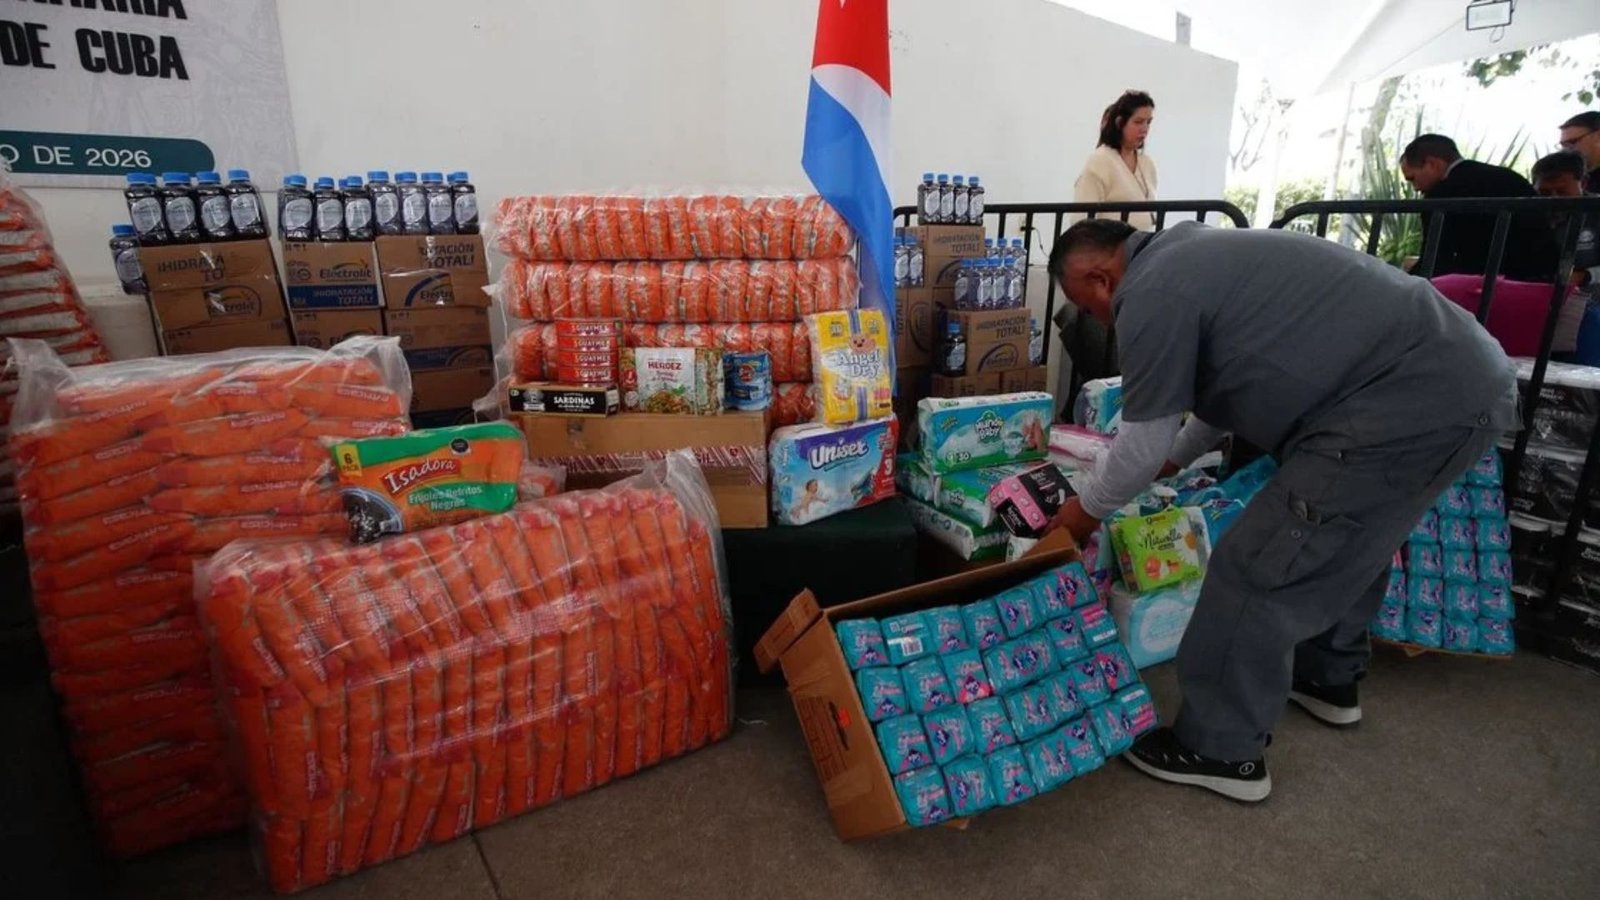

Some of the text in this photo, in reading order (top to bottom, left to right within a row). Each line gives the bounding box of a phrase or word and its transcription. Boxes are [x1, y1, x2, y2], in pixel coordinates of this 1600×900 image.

[0, 20, 189, 80] DE CUBA
[33, 145, 74, 165] DE
[85, 148, 152, 168] 2026
[319, 267, 372, 280] Electrolit
[647, 361, 683, 371] HERDEZ
[836, 349, 881, 369] Angel
[553, 396, 595, 405] SARDINAS
[344, 453, 353, 464] 6
[810, 441, 869, 469] Uniset
[384, 458, 457, 494] Isadora
